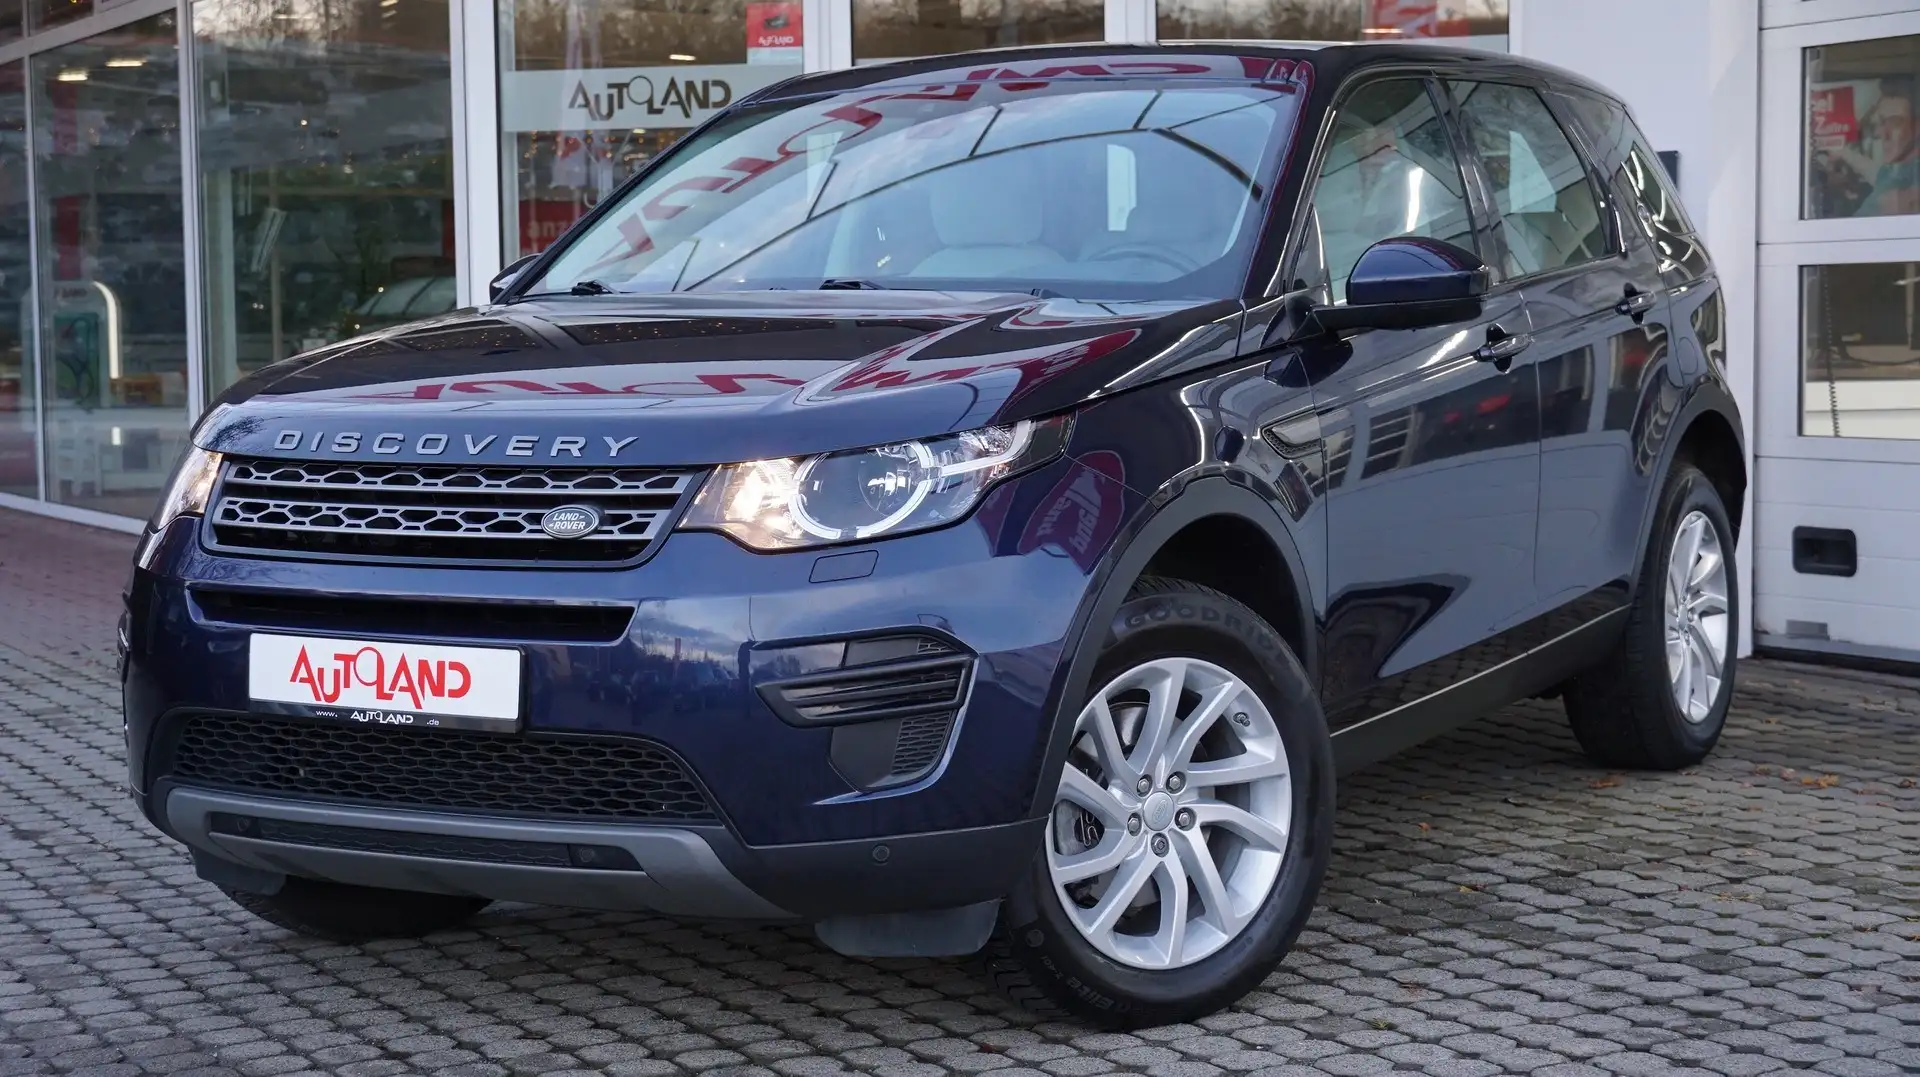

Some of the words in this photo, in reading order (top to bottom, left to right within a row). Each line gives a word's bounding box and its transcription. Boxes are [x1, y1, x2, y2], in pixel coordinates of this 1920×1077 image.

[568, 75, 732, 121] AUTOLAND
[273, 430, 640, 457] DISCOVERY
[553, 521, 586, 529] ROVER
[290, 644, 471, 709] AUTOLAND
[316, 710, 338, 718] www.
[351, 711, 414, 725] AUTOLAND
[426, 718, 440, 726] .de
